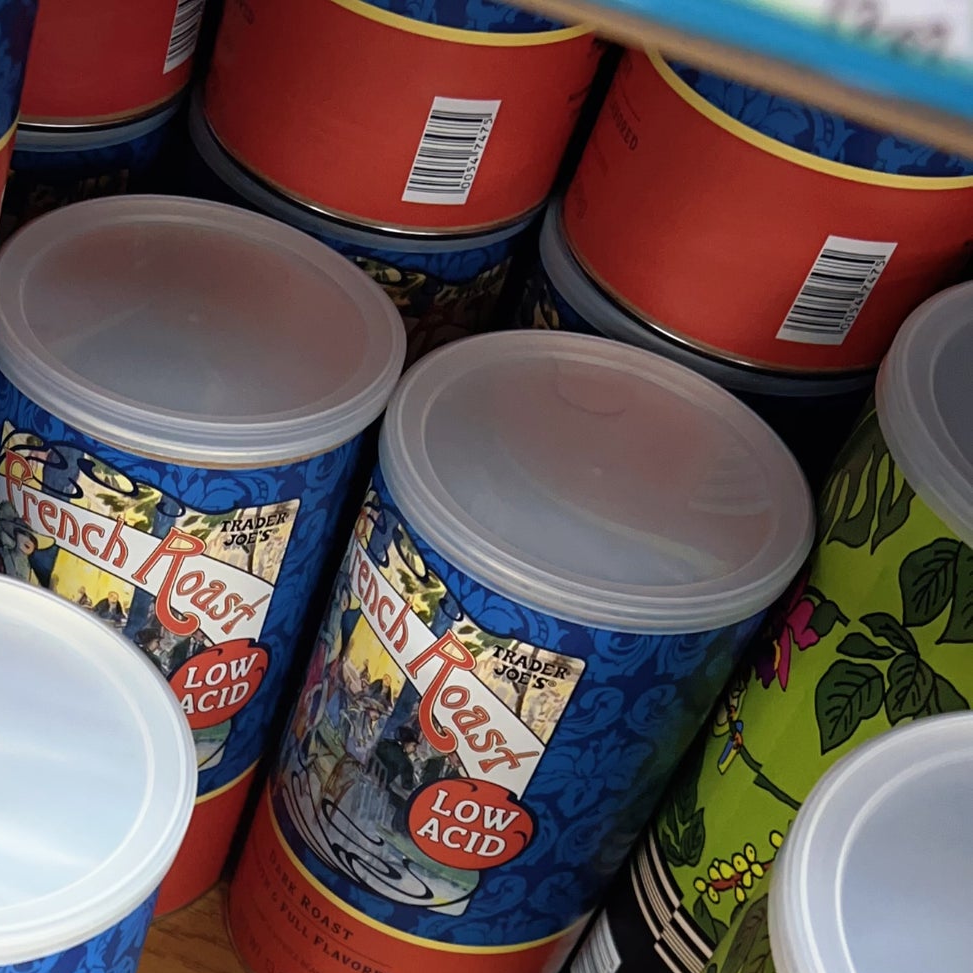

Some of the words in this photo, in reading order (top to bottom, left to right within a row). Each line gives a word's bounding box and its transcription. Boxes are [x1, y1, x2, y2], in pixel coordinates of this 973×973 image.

[220, 511, 289, 535] TRADER
[223, 527, 273, 547] JOE'S
[5, 449, 130, 569] French
[131, 526, 271, 637] Roast
[183, 652, 259, 690] LOW
[493, 645, 570, 682] TRADER
[493, 664, 548, 691] JOE'S
[178, 681, 251, 715] ACID
[406, 628, 540, 774] Roast
[430, 788, 520, 833] LOW
[417, 818, 506, 858] ACID
[280, 902, 310, 939] FULL
[300, 893, 355, 943] ROAST
